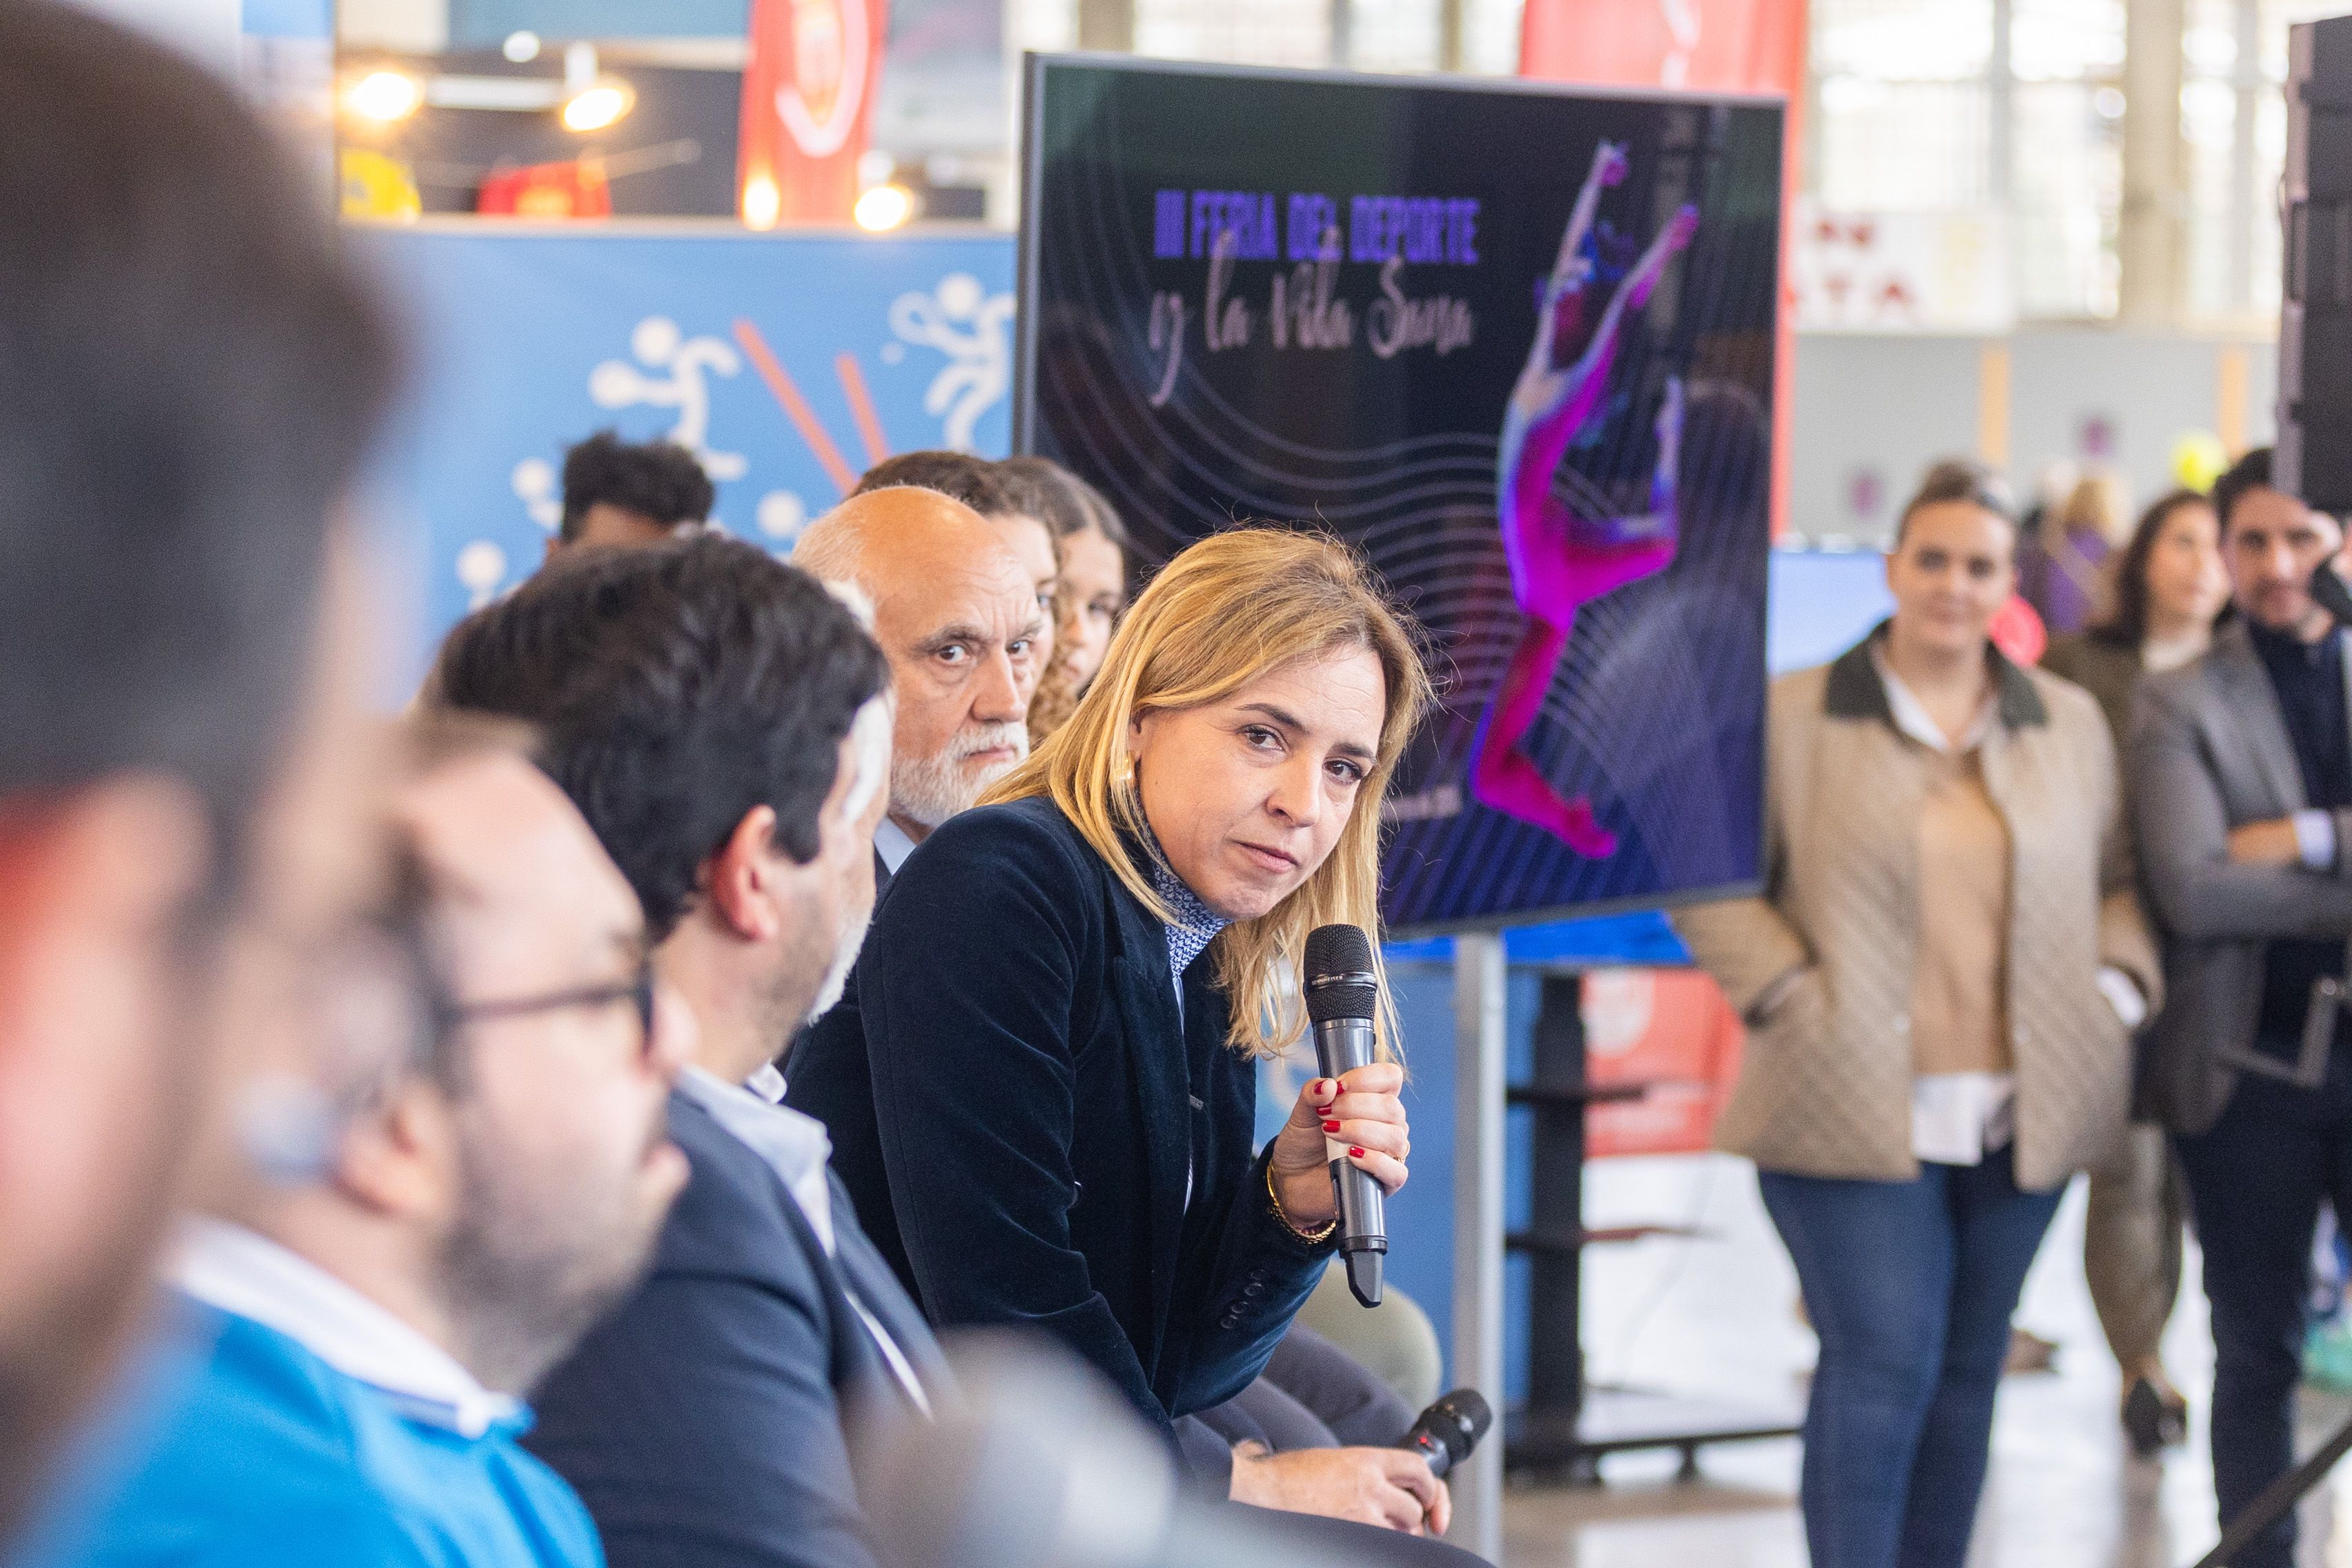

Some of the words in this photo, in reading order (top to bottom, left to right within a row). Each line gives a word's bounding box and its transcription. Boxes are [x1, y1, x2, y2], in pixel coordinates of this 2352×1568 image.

[1191, 190, 1279, 261] FERIA
[1288, 192, 1344, 262] DEL
[1350, 195, 1480, 265] DEPORTE
[1148, 288, 1186, 408] y
[1205, 228, 1249, 351] la
